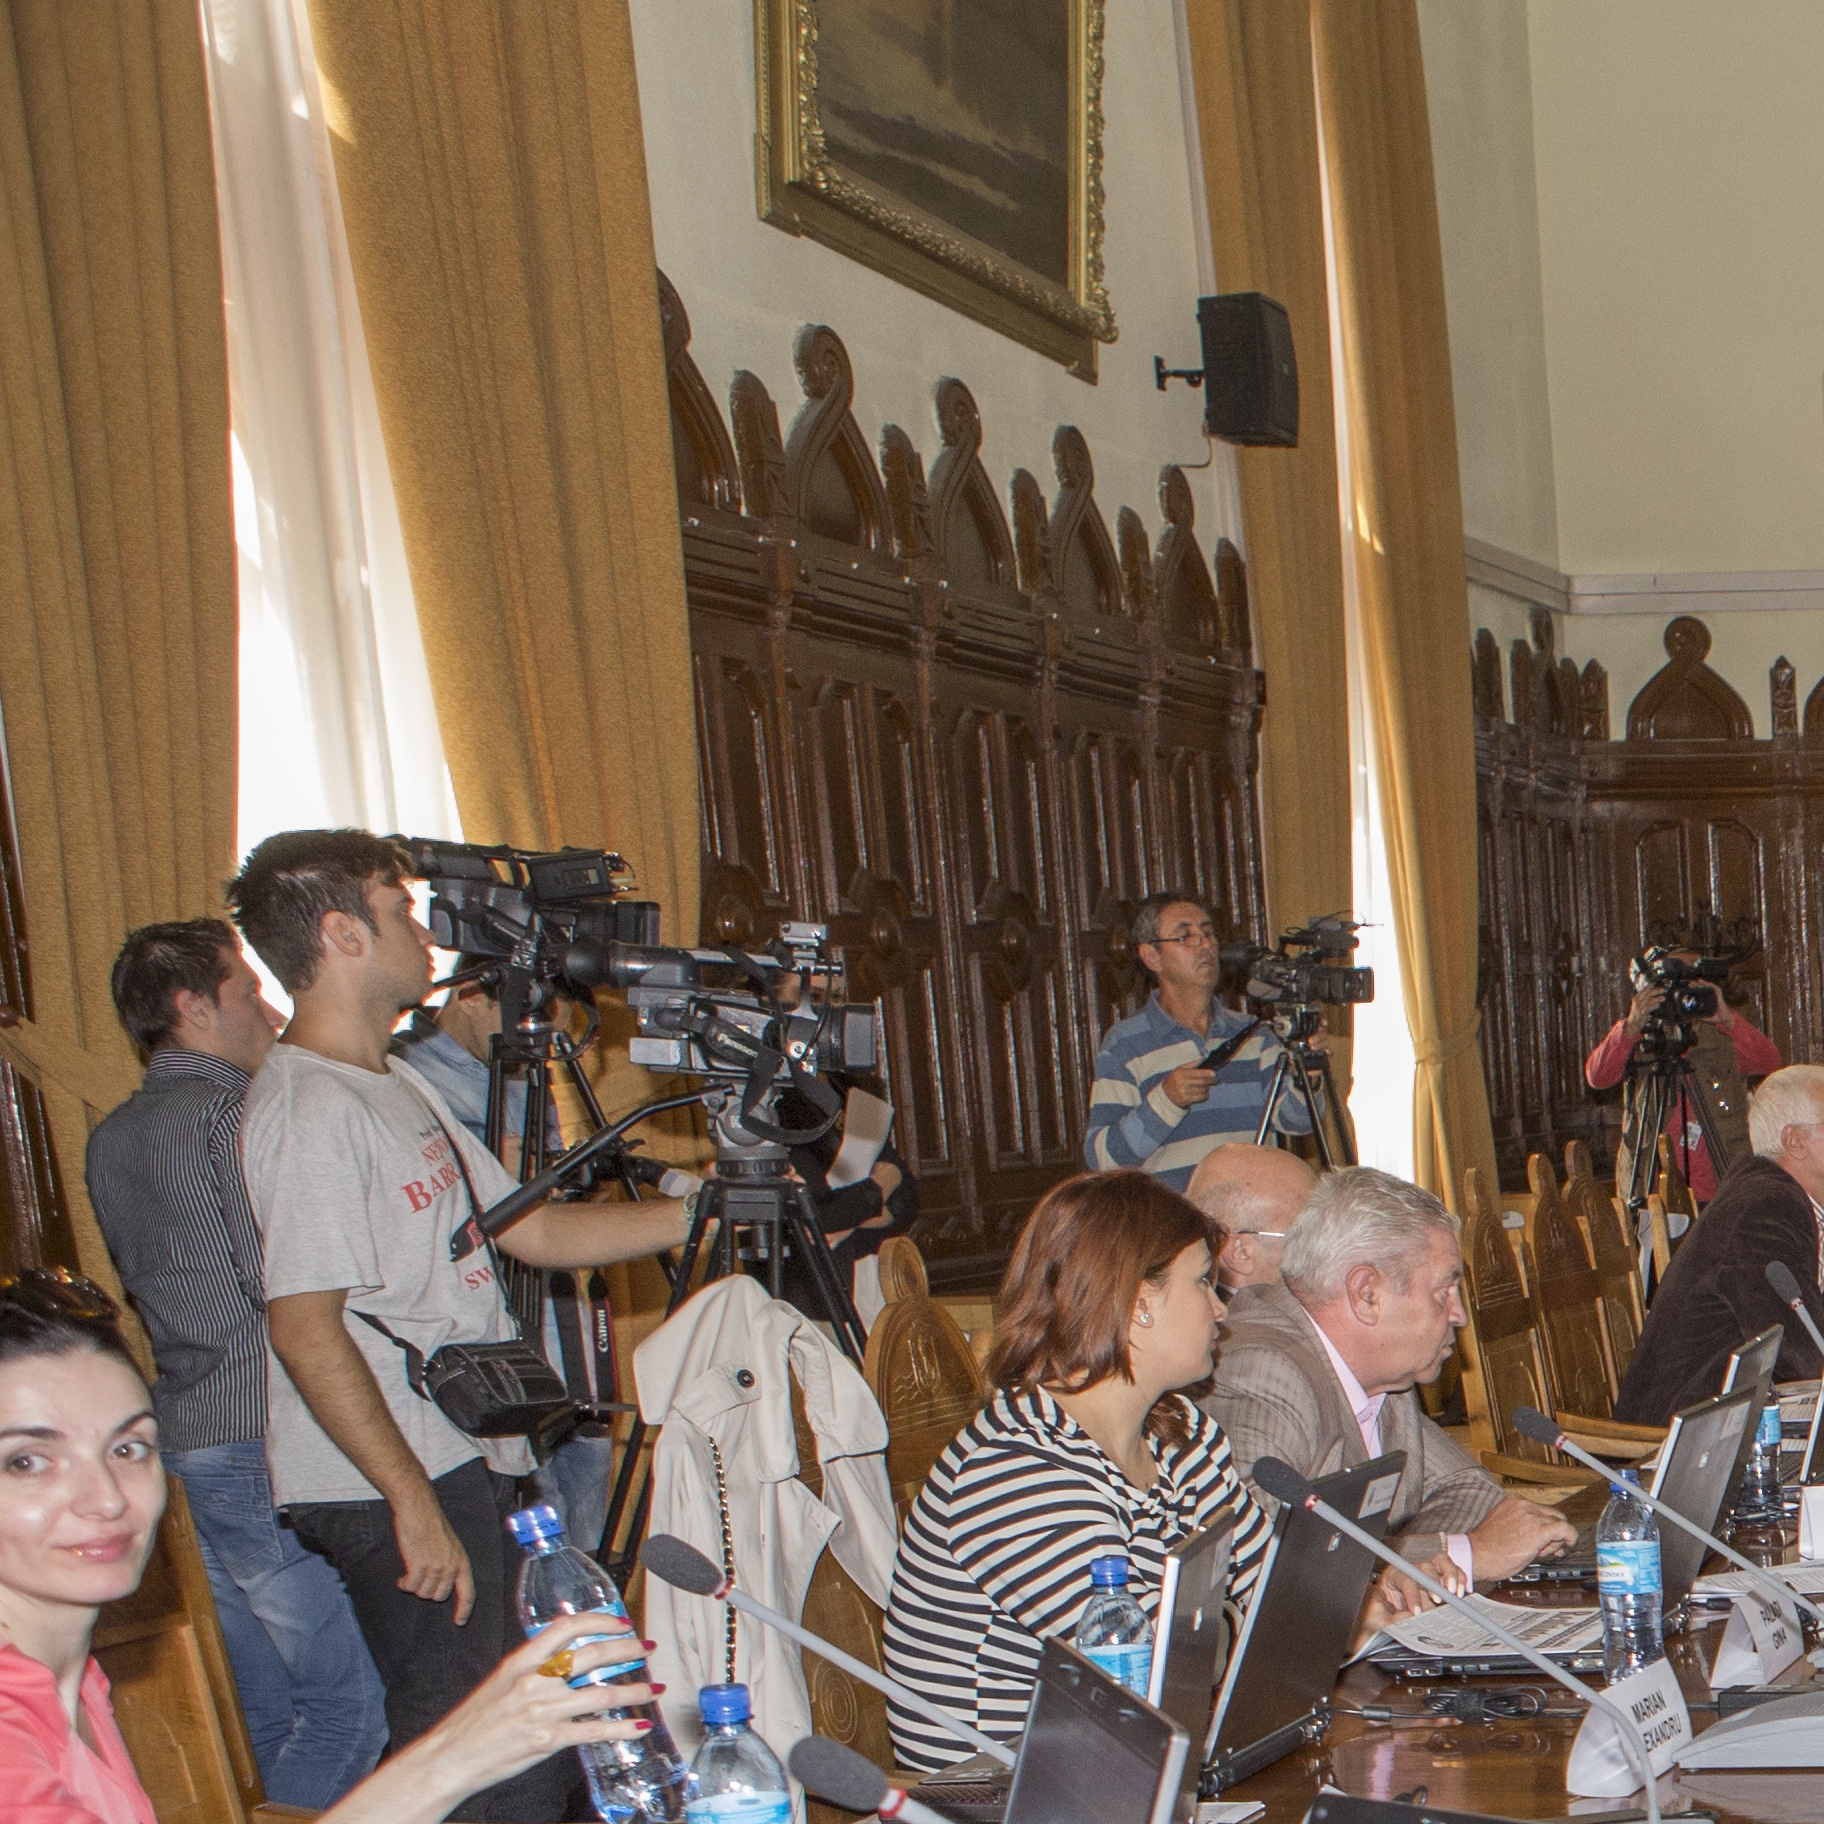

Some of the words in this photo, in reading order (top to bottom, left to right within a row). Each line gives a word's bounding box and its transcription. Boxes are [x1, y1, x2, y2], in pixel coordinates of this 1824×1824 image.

[401, 1159, 461, 1214] BARR
[1630, 1689, 1667, 1725] MARIAN
[1642, 1712, 1683, 1754] EXANDRU
